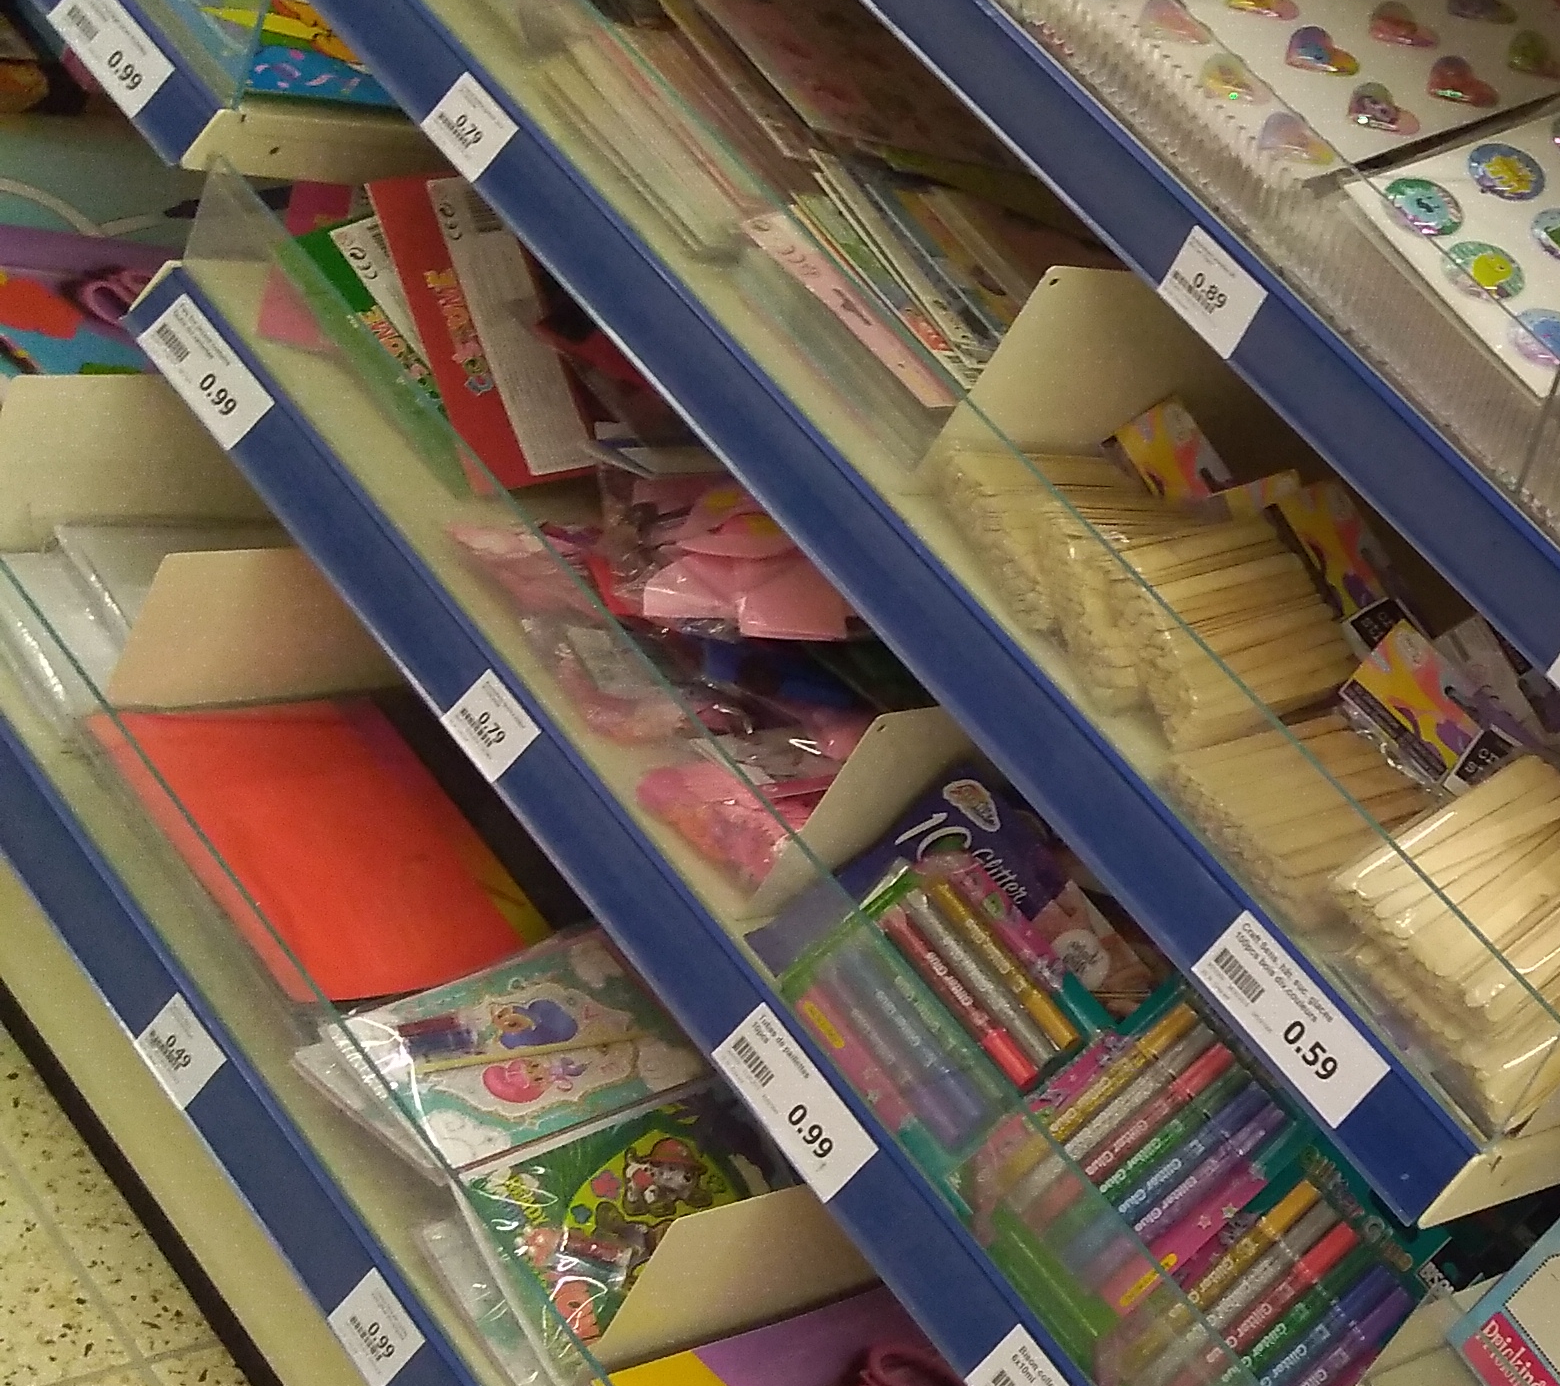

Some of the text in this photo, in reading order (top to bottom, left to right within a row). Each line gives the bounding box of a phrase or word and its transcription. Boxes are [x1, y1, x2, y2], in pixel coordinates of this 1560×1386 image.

[105, 48, 143, 92] 0.99
[454, 112, 483, 145] 0.79
[1191, 270, 1228, 312] 0.89
[197, 371, 238, 418] 0.99
[477, 710, 506, 745] 0.79
[970, 839, 1030, 913] Glitter
[1241, 921, 1263, 945] Craft
[923, 949, 974, 1009] Glitter Glue
[1258, 957, 1277, 977] bois
[165, 1032, 191, 1068] 0.49
[750, 1021, 770, 1045] 10pcs
[758, 1014, 811, 1081] Tubes de paillettes
[1281, 1019, 1340, 1083] 0.59
[786, 1101, 835, 1162] 0.99
[1083, 1116, 1149, 1179] Glitter Glue
[1096, 1132, 1164, 1198] Glitter Glue
[1115, 1154, 1184, 1218] Glitter Glue
[1131, 1172, 1198, 1236] Glitter Glue
[366, 1320, 395, 1360] 0.99
[1233, 1299, 1274, 1342] Glitter
[1249, 1319, 1289, 1361] Glitter
[1010, 1352, 1036, 1384] 6x10ml
[1017, 1344, 1040, 1371] Bison
[1268, 1339, 1309, 1383] Glitter
